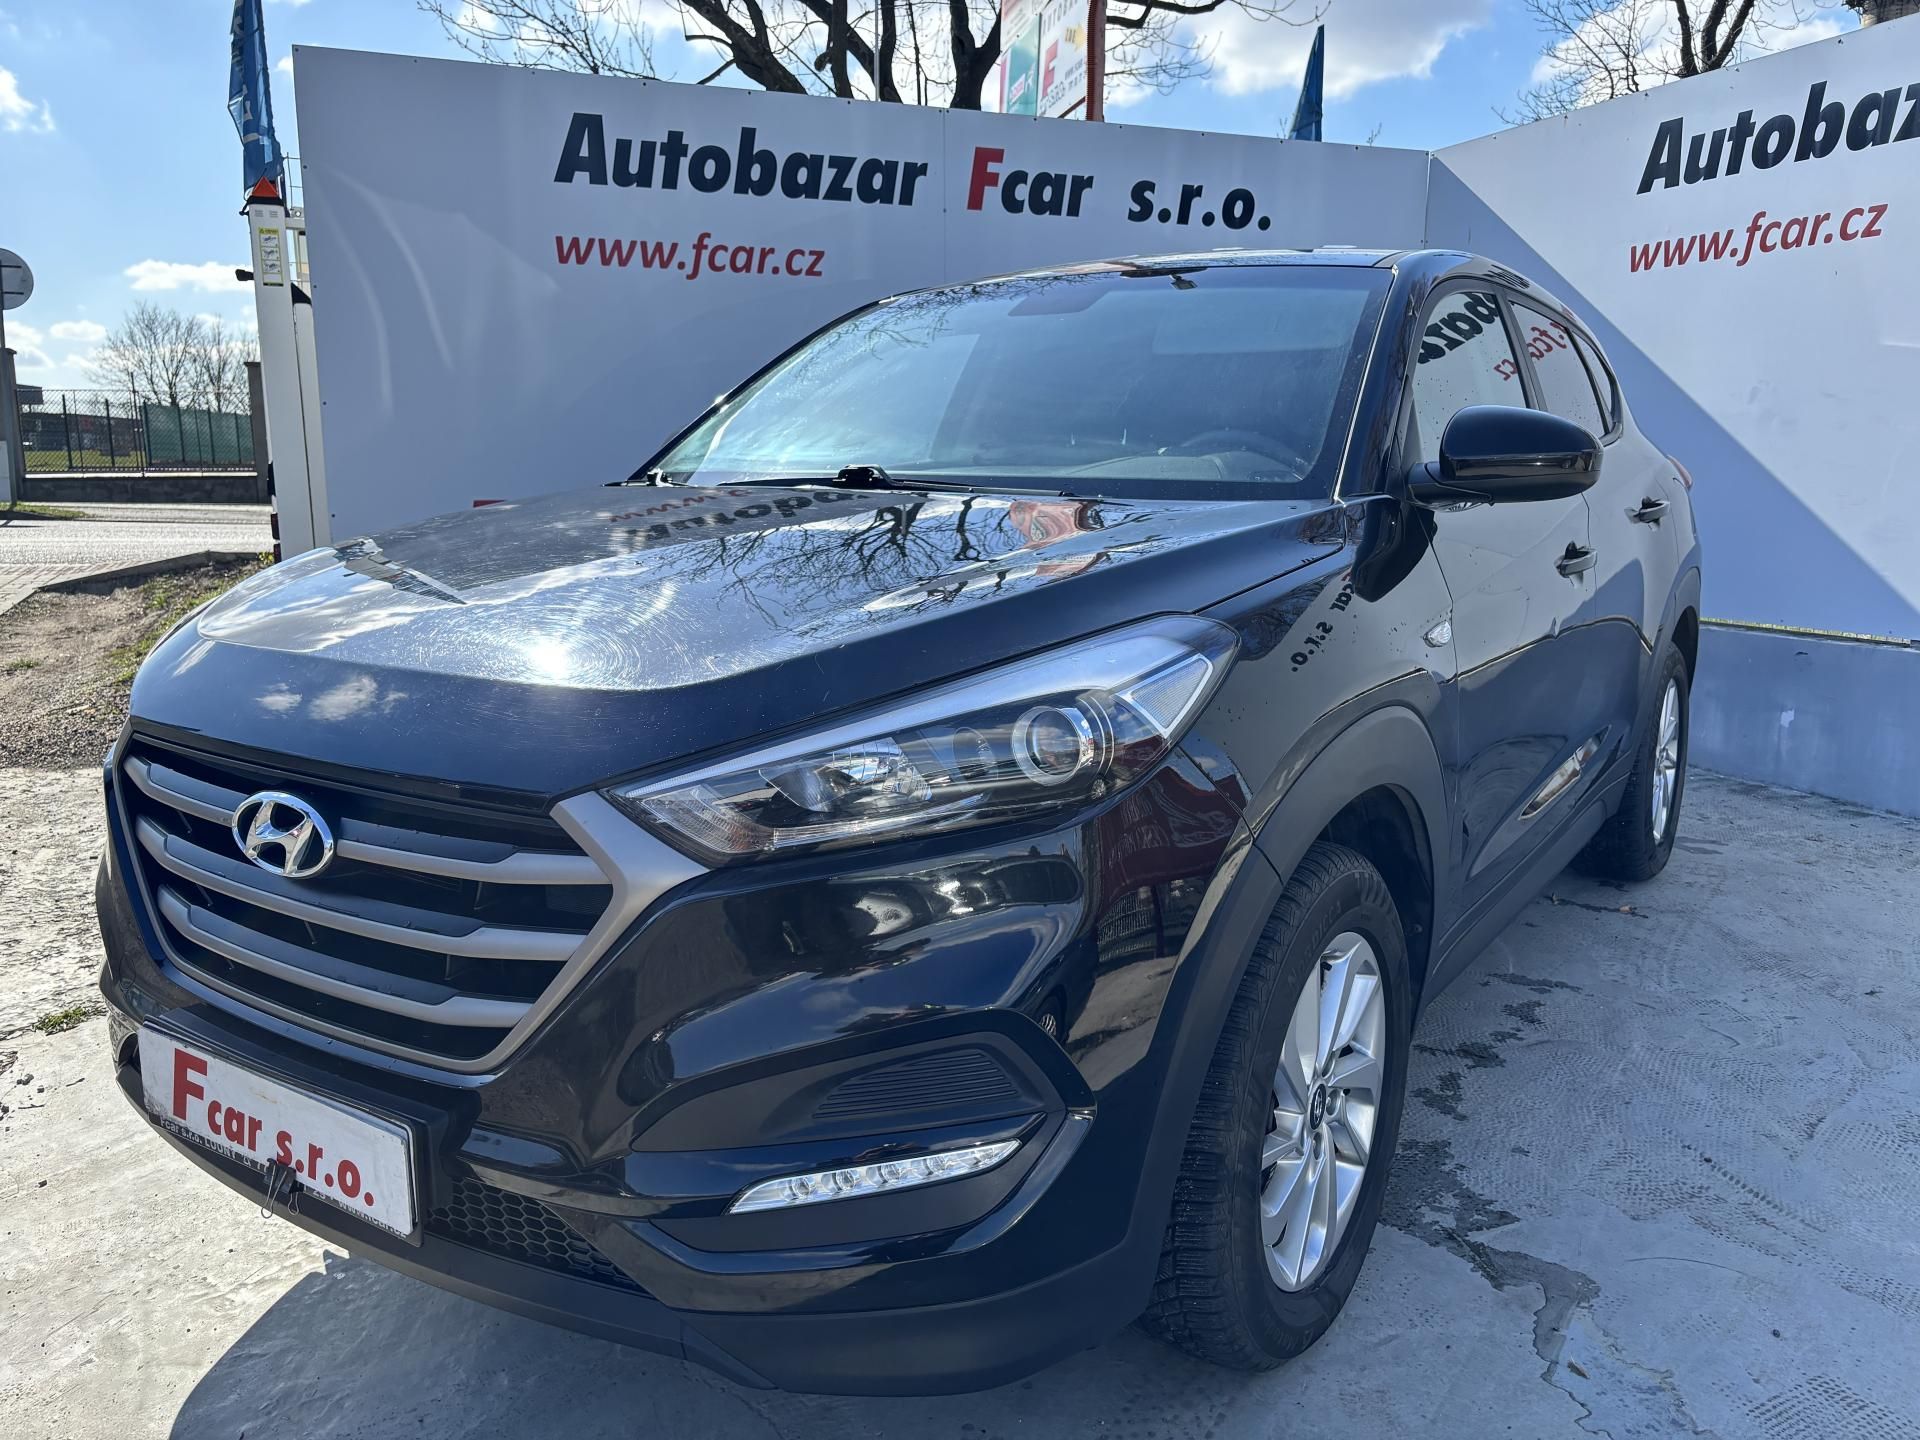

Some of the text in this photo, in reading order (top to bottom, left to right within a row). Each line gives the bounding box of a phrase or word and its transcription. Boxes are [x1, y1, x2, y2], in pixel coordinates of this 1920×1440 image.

[554, 112, 1271, 231] Autobazar Fcar s.r.o.
[555, 232, 825, 280] www.fcar.cz
[1630, 203, 1888, 273] www.fcar.cz
[275, 1130, 375, 1207] s.r.o.
